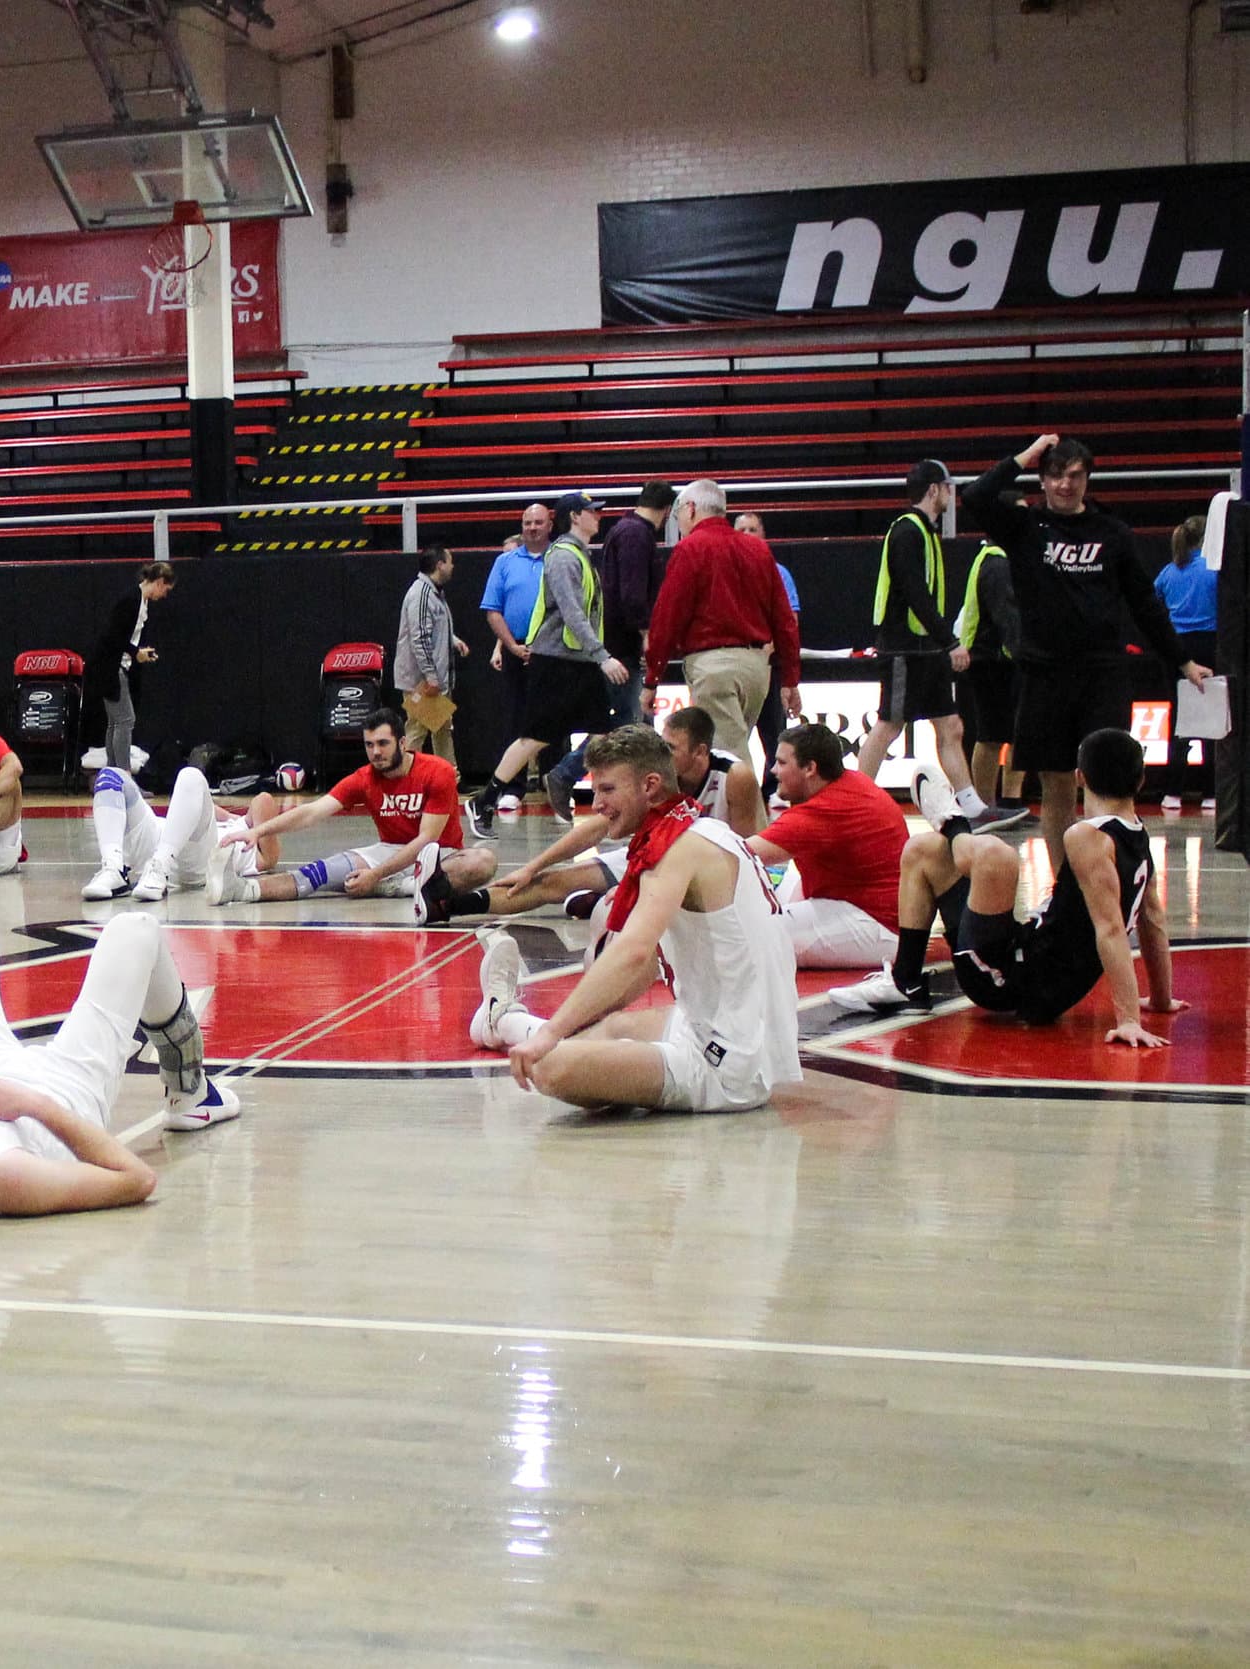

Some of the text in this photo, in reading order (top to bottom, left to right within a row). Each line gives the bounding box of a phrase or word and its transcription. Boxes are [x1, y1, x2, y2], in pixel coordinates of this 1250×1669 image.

[9, 282, 90, 310] MAKE
[1044, 542, 1103, 564] NGU
[332, 651, 374, 668] NGU
[380, 793, 423, 811] NGU
